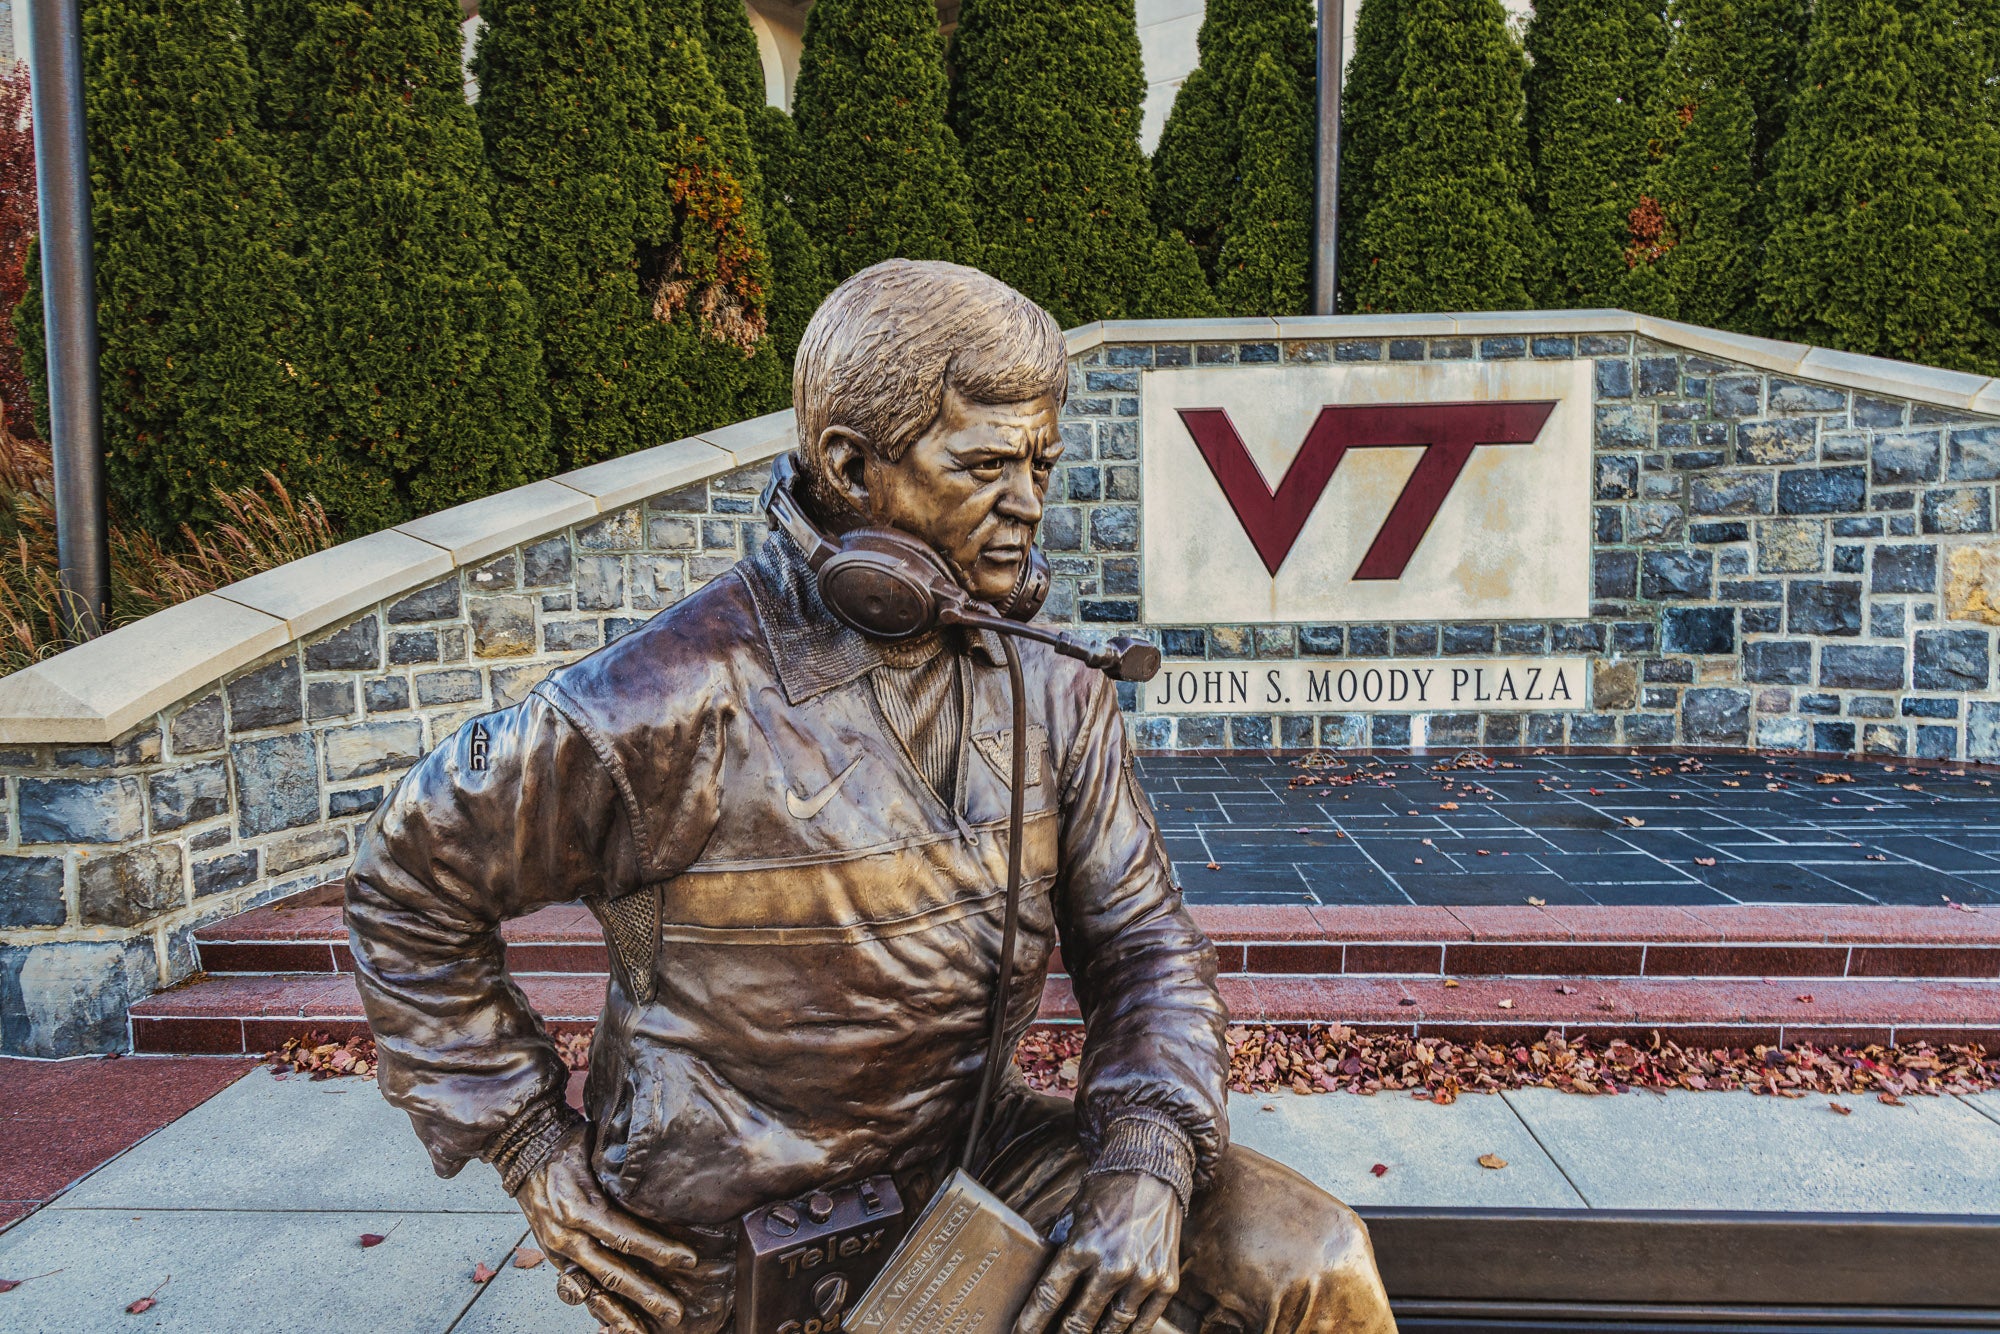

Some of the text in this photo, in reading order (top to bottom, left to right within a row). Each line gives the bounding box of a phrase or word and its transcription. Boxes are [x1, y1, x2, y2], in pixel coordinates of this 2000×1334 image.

[1176, 399, 1562, 579] VT
[1157, 666, 1573, 705] JOHN S. MOODY PLAZA
[473, 723, 488, 769] ACC
[779, 1228, 885, 1279] Telex
[887, 1242, 942, 1299] VIRGINIA
[934, 1205, 970, 1244] TECH
